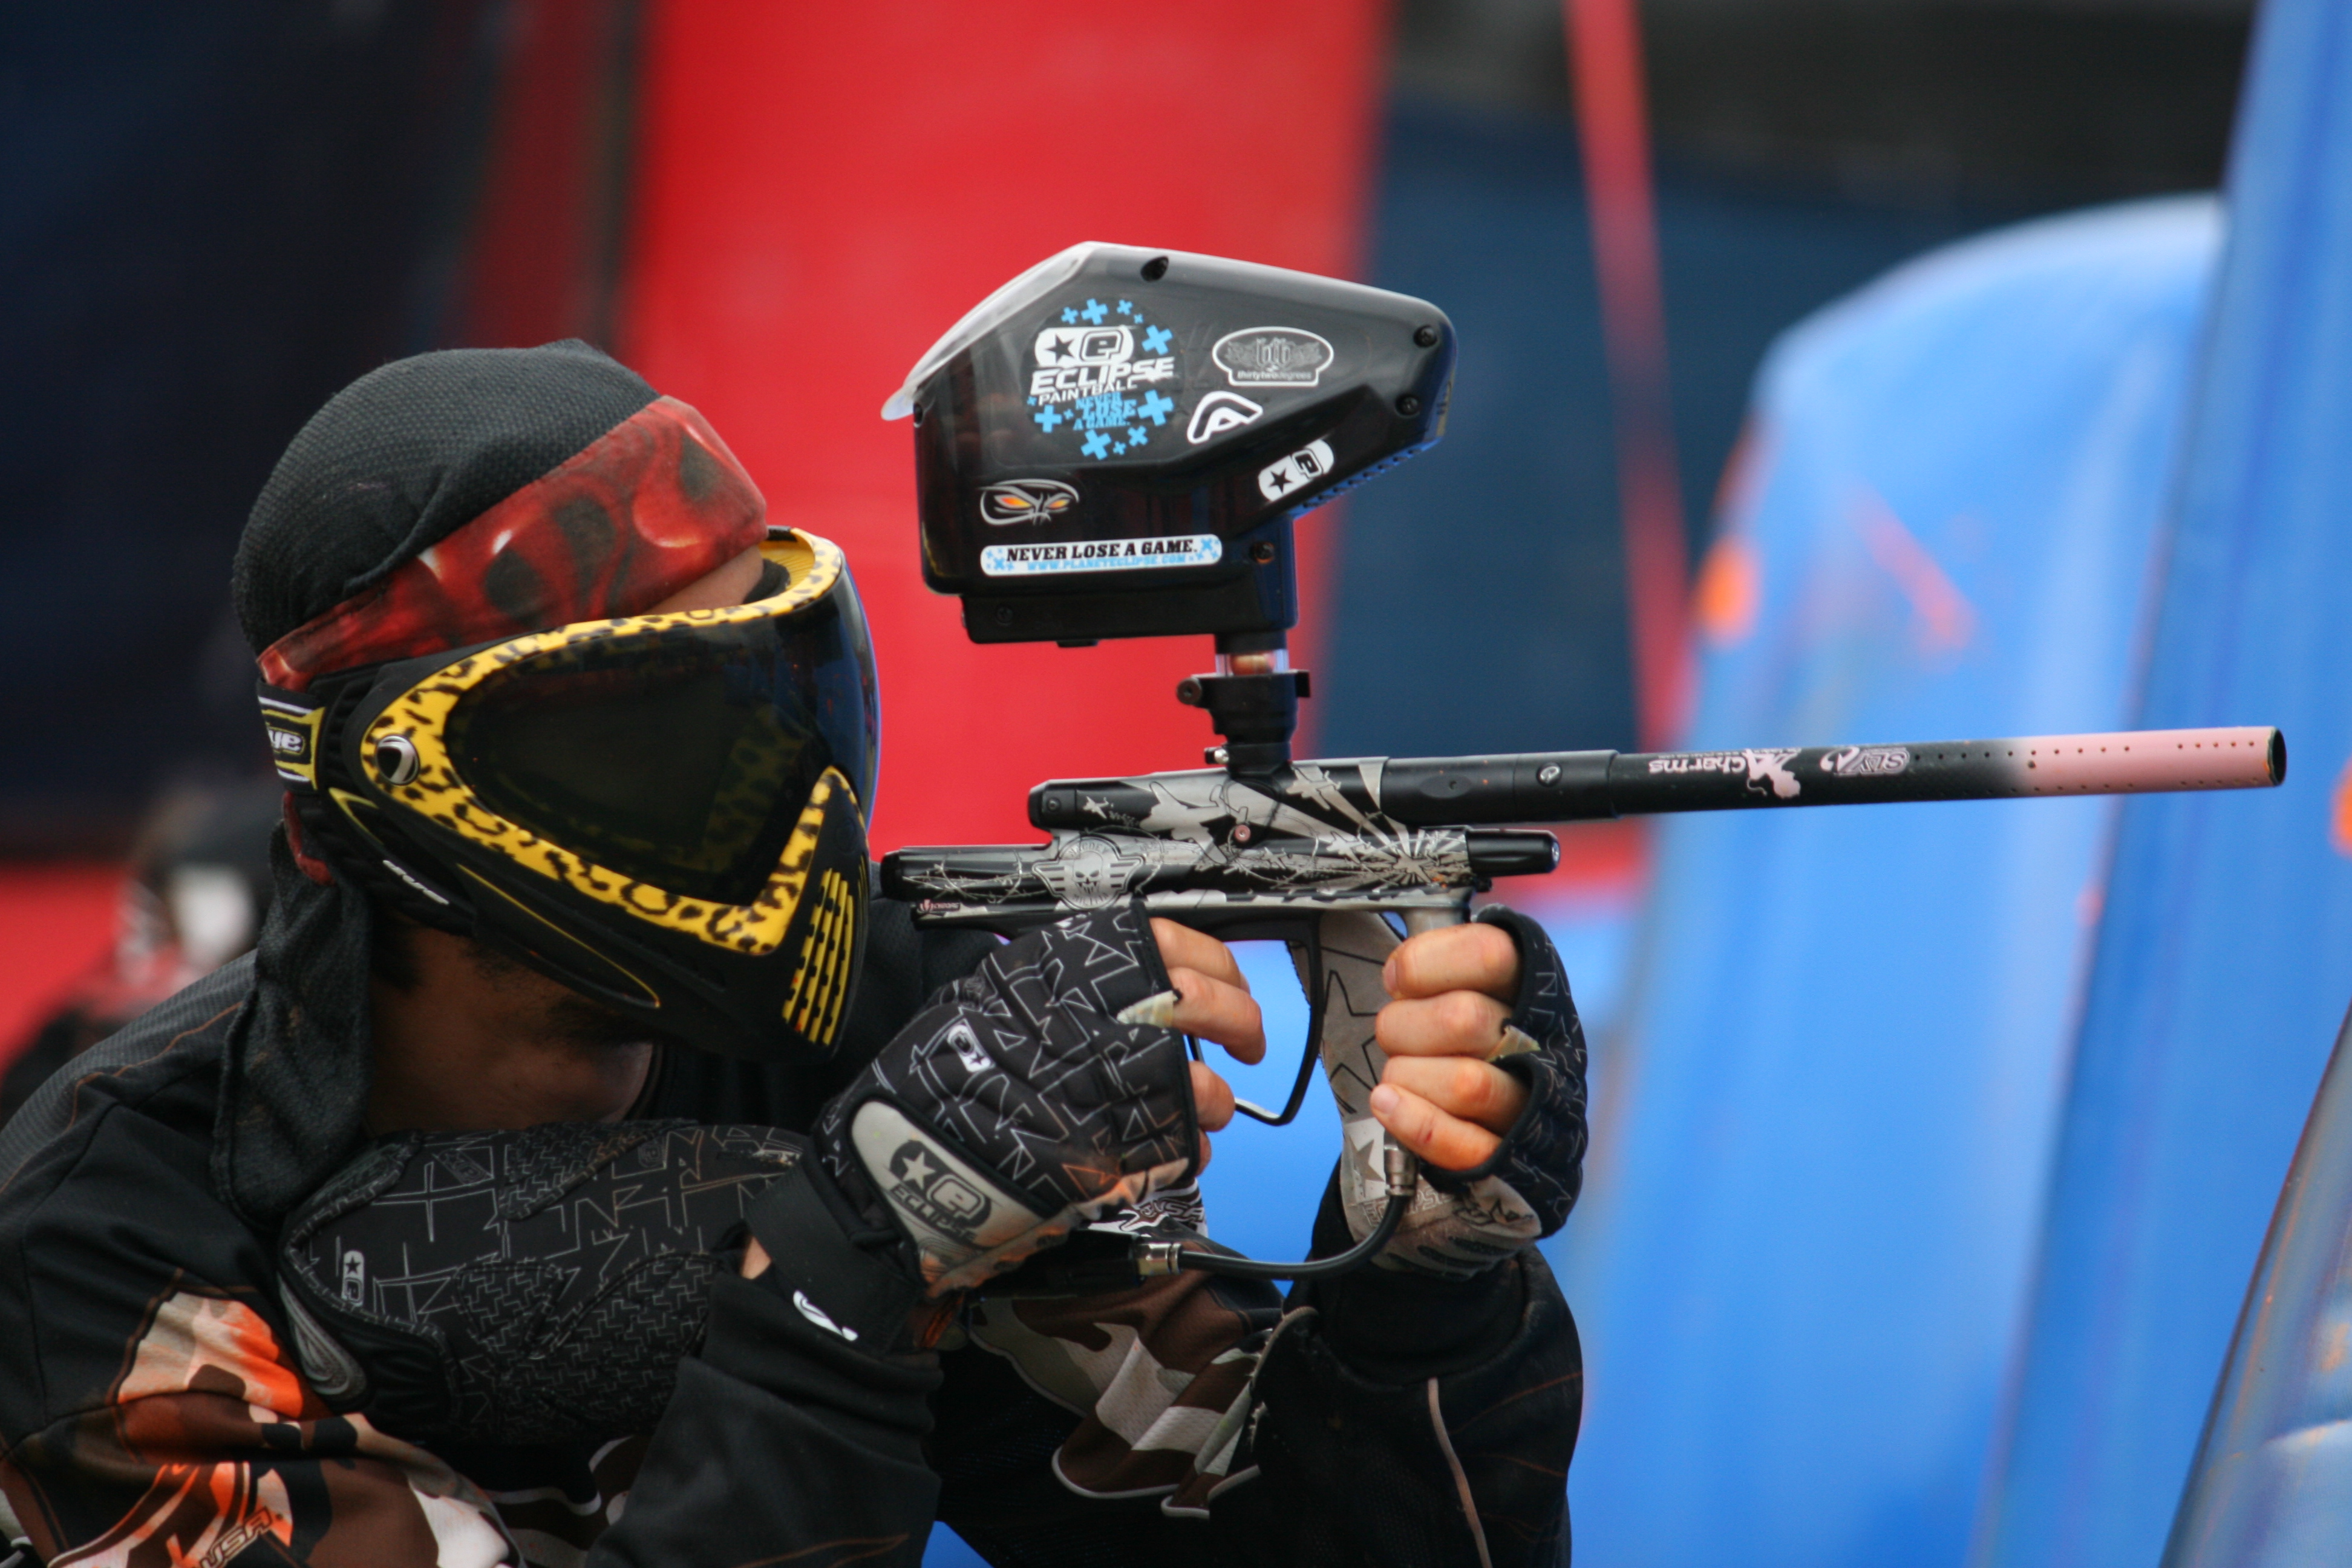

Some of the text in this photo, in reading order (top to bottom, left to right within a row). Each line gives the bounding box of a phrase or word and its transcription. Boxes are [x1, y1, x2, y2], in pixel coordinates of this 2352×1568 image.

[1030, 357, 1175, 396] ECLIPSE
[1038, 375, 1138, 406] PAINTBALL
[1007, 539, 1198, 561] NEVER LOSE A GAME.
[199, 1506, 272, 1567] USA
